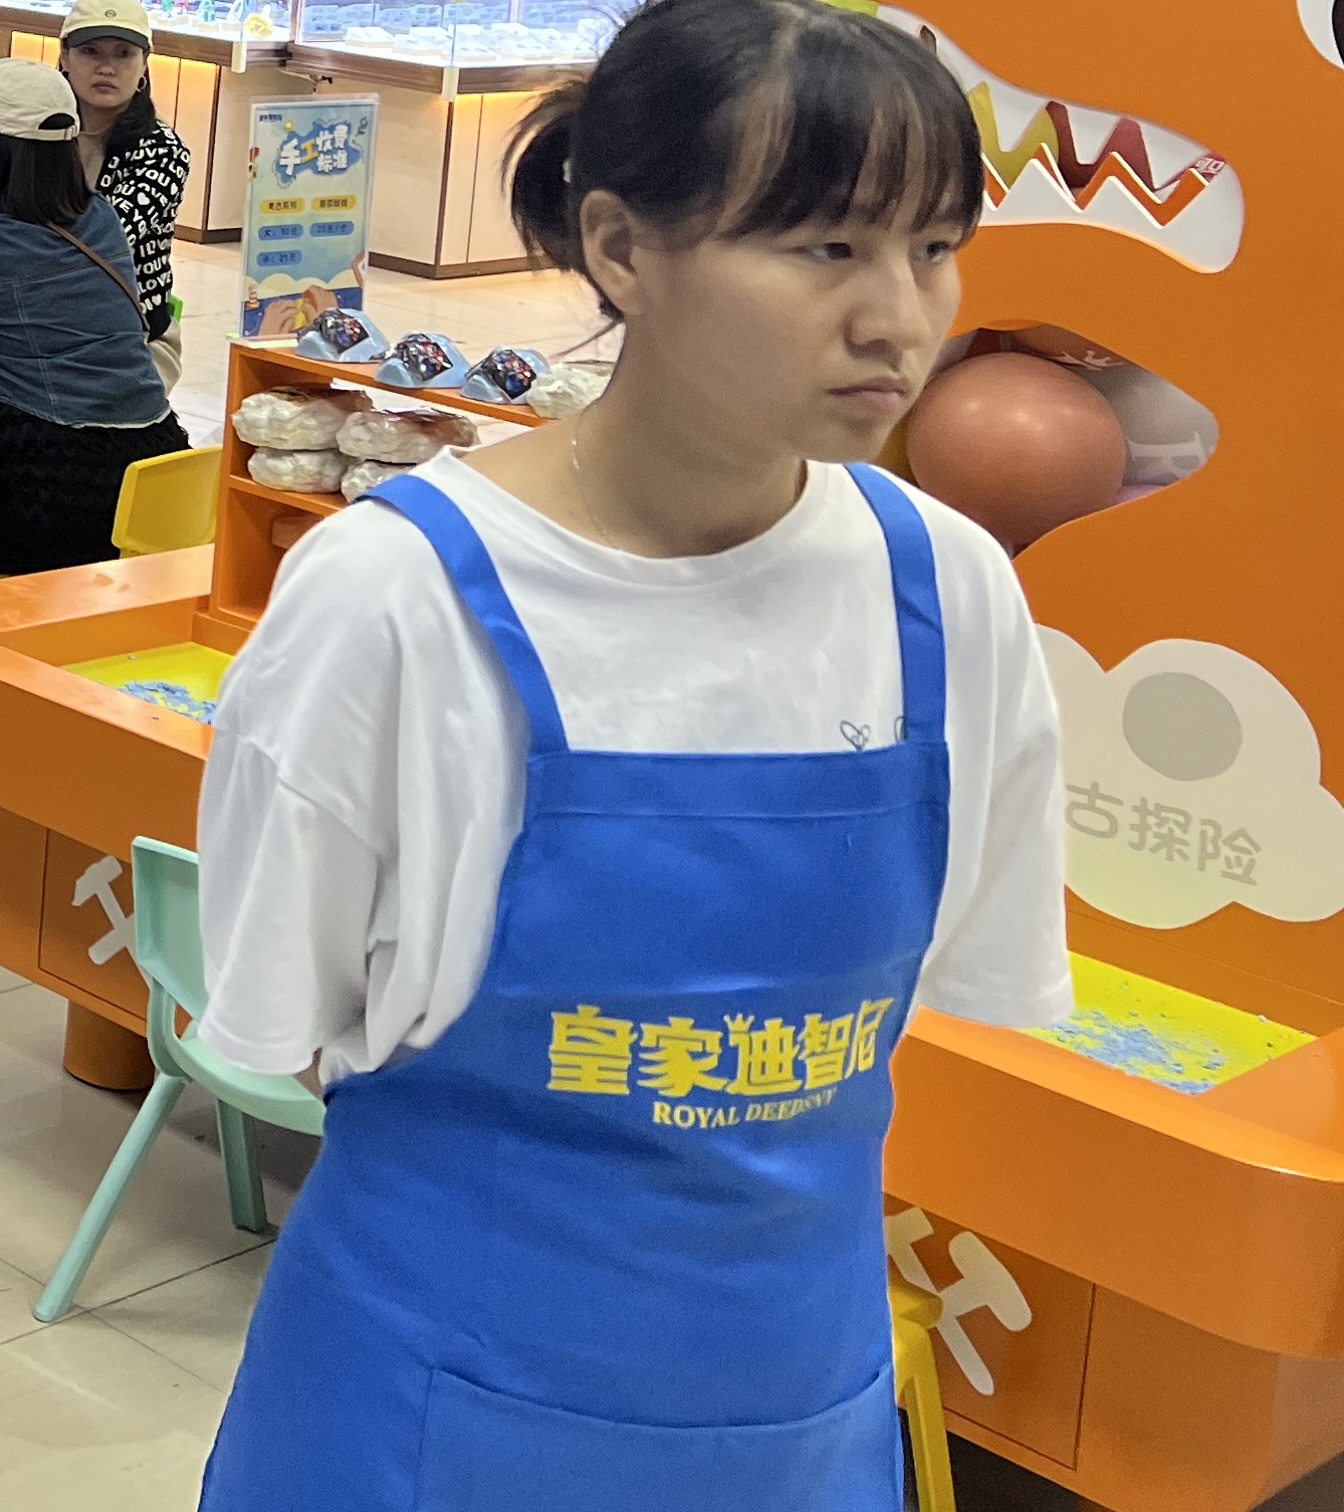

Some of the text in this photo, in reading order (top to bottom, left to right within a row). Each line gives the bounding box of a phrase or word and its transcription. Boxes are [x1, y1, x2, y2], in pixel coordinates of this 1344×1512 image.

[547, 996, 894, 1098] 皇家迪智尼
[652, 1100, 740, 1129] ROYAL
